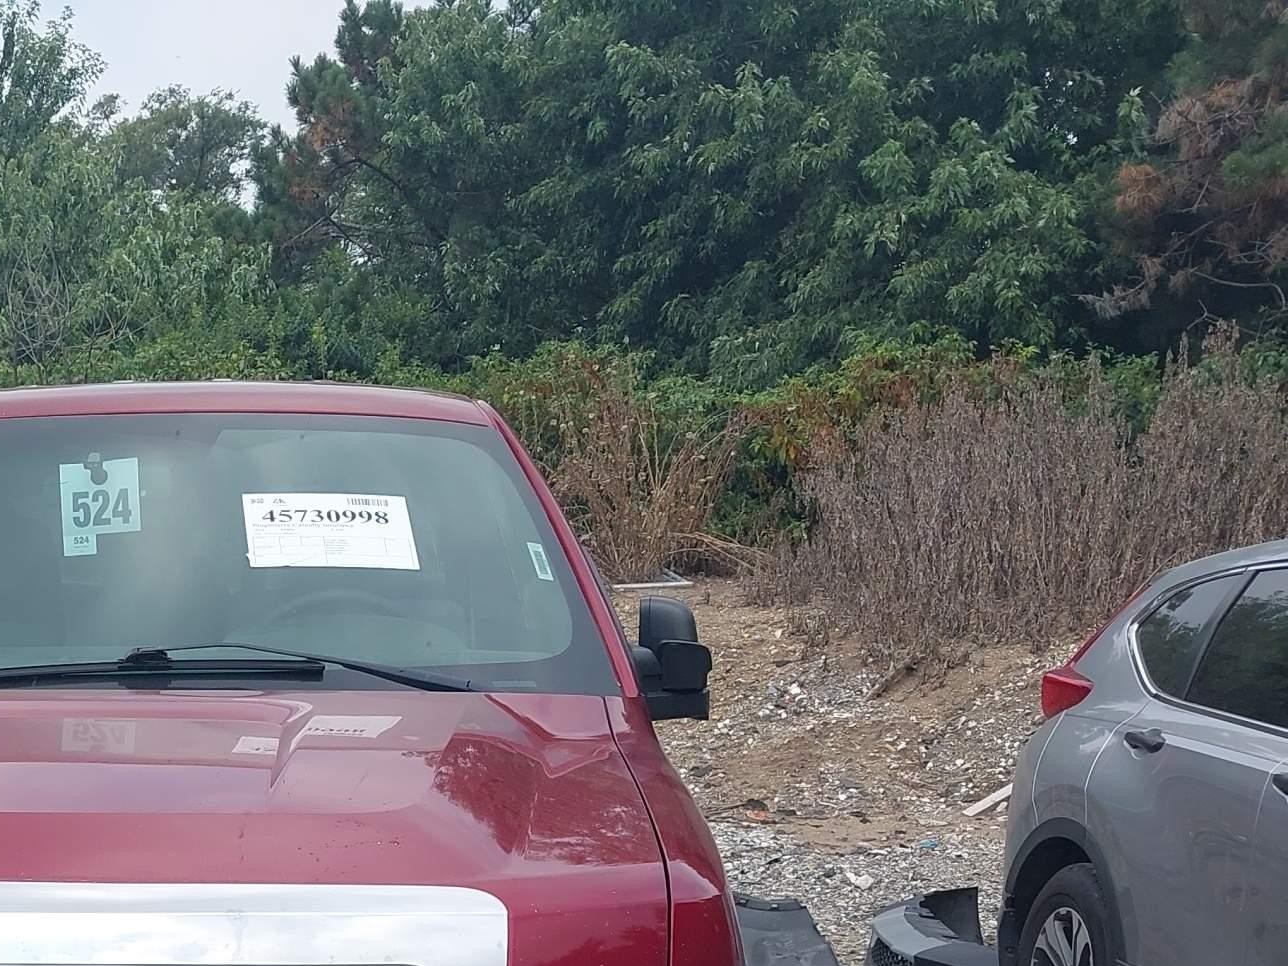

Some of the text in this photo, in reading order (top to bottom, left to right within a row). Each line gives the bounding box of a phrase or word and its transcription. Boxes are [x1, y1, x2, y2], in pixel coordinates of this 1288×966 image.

[72, 488, 132, 528] 524
[262, 509, 389, 524] 45730998
[74, 536, 89, 545] 524
